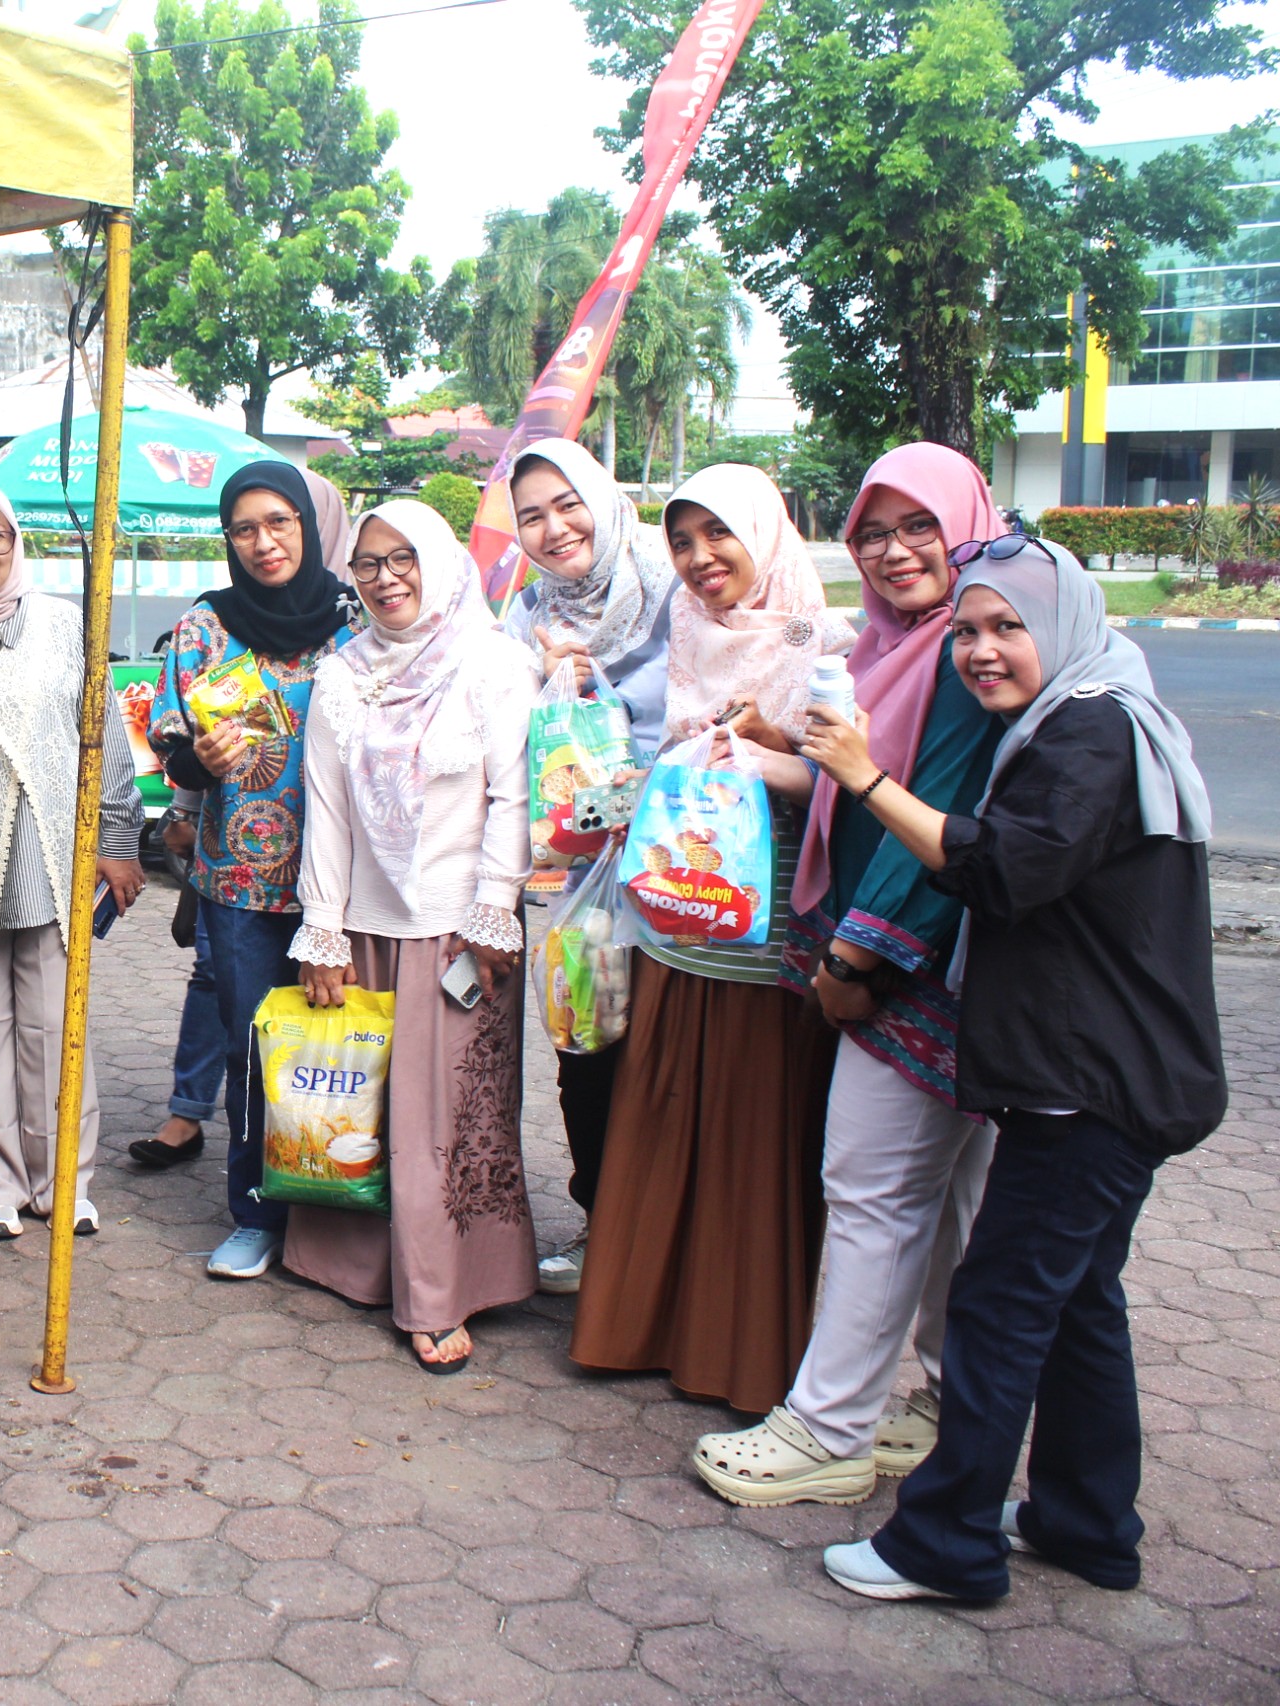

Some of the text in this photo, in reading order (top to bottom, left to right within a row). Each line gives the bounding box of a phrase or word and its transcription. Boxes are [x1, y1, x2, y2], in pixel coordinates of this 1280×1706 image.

[697, 888, 733, 904] HAPPY
[637, 889, 718, 921] Kokola
[353, 1031, 386, 1046] bulog
[291, 1066, 367, 1095] SPHP
[302, 1158, 311, 1170] 5
